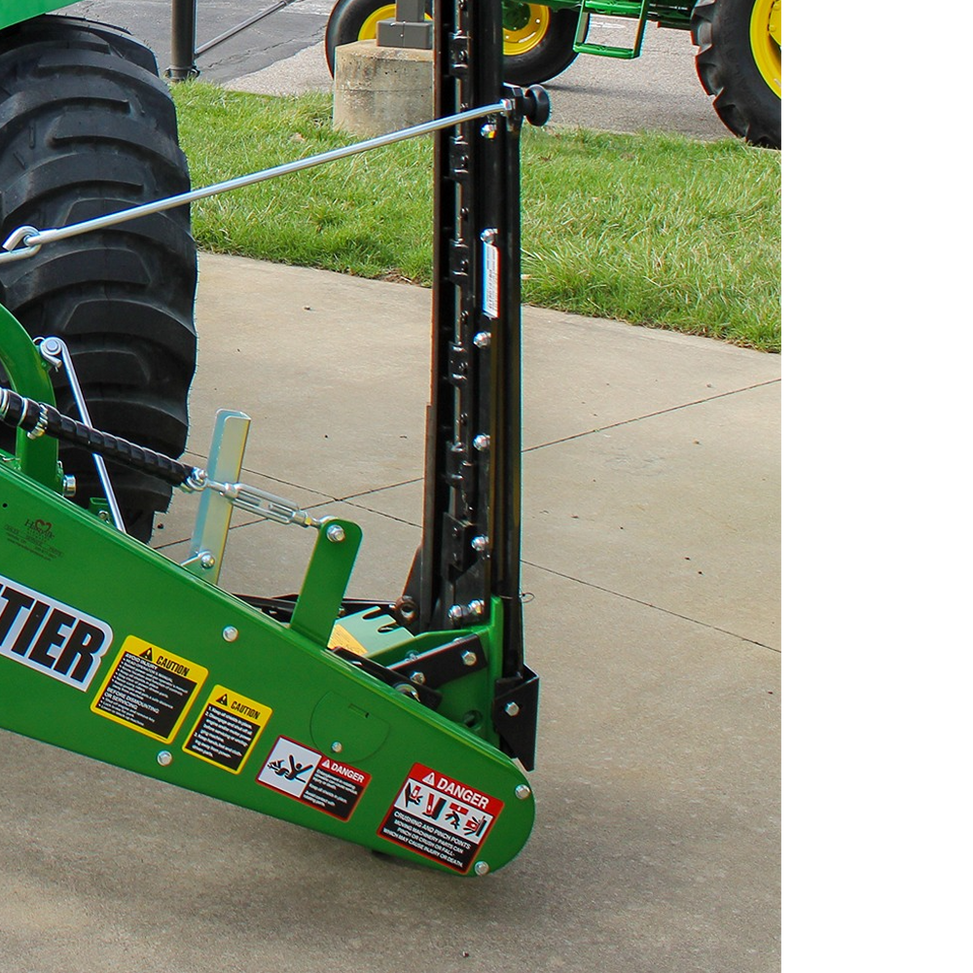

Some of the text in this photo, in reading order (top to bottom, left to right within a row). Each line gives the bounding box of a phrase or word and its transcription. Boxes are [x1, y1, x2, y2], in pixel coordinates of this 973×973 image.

[156, 655, 191, 677] CAUTION
[231, 701, 261, 720] CAUTION
[331, 761, 365, 783] DANGER
[436, 777, 490, 810] DANGER
